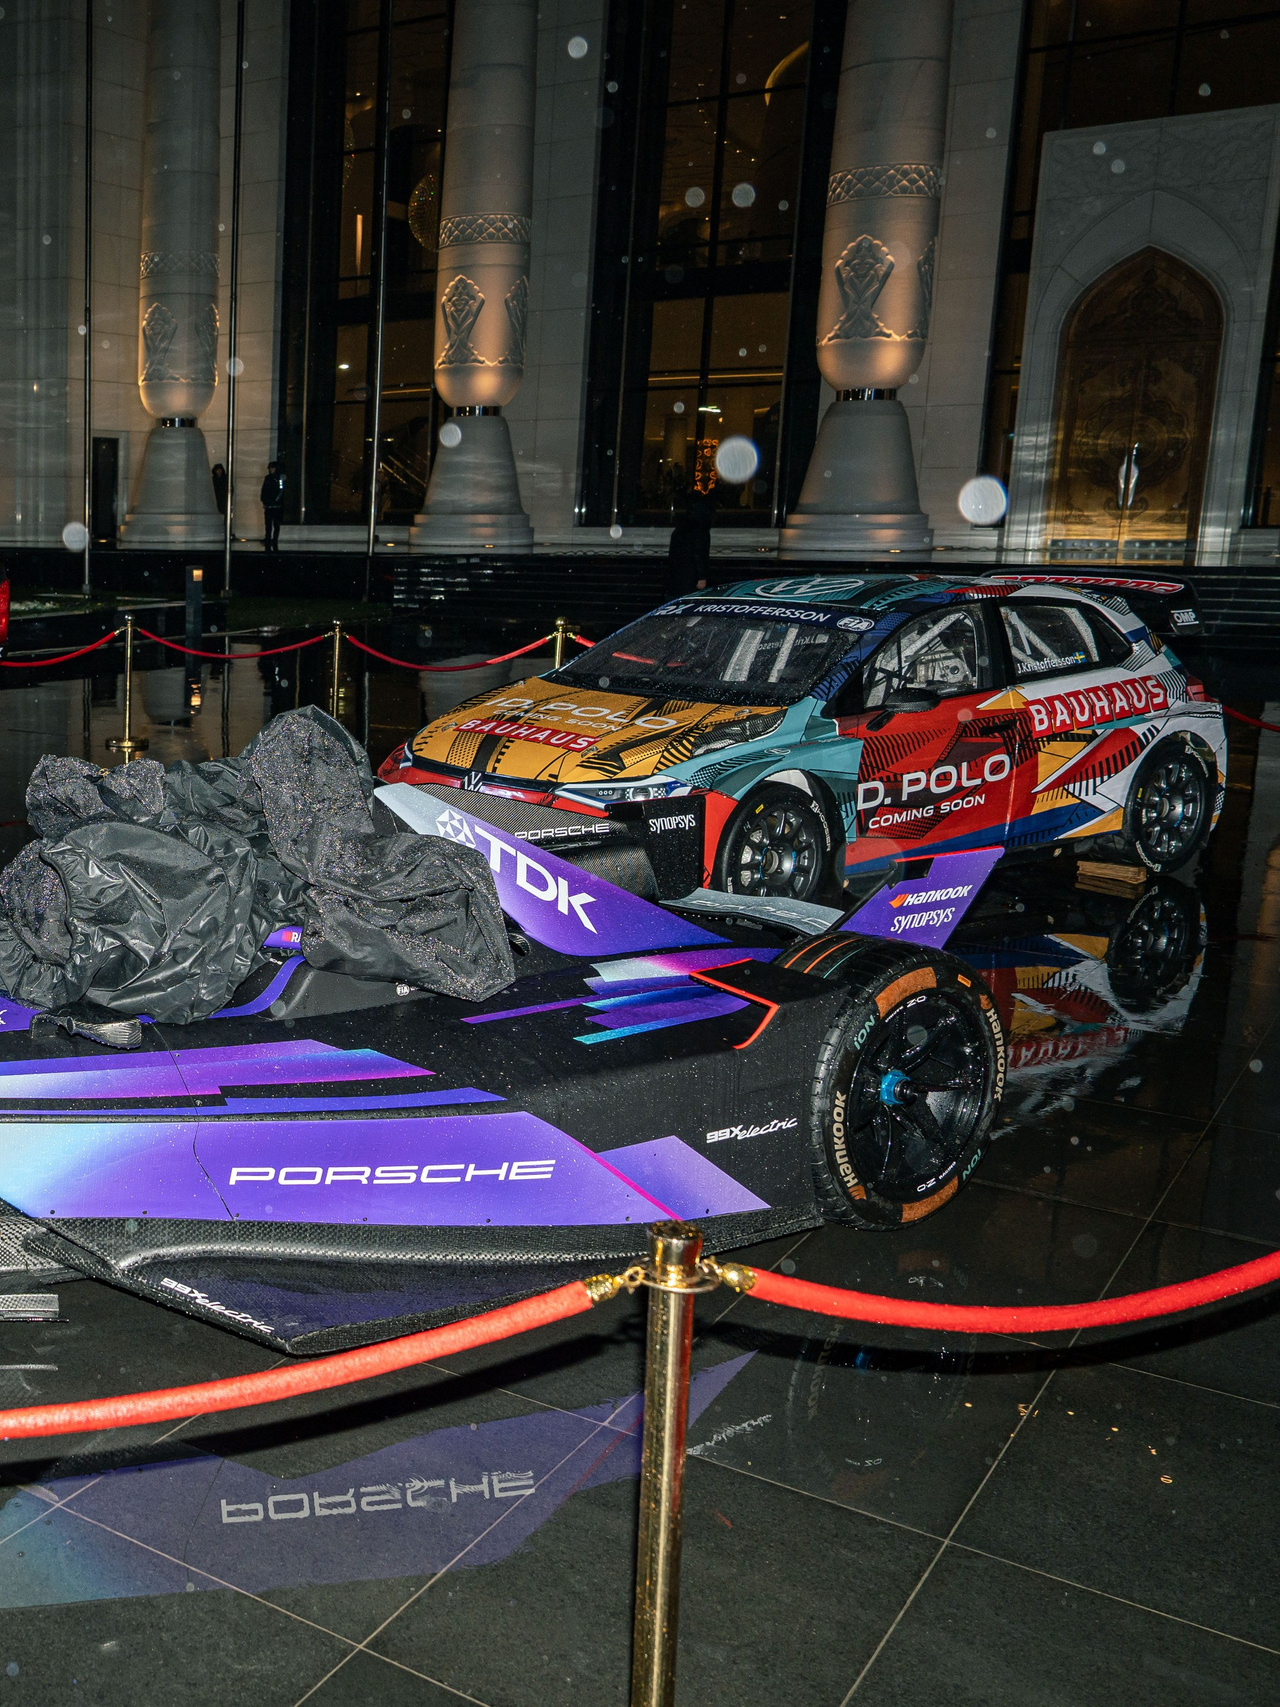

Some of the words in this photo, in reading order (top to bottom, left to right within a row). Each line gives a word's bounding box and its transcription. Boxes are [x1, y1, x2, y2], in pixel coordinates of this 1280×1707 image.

[694, 604, 832, 623] KRISTOFFERSSON
[1173, 612, 1197, 623] OMP
[539, 702, 678, 729] POLO
[1028, 678, 1166, 732] BAUHAUS
[493, 709, 564, 722] COMING
[565, 718, 623, 732] SOON
[461, 719, 596, 750] BAUHAUS
[902, 753, 1011, 802] POLO
[868, 805, 935, 829] COMING
[940, 794, 986, 814] SOON
[515, 823, 611, 840] PORSCHE
[475, 821, 599, 935] TDK
[228, 1160, 557, 1186] PORSCHE
